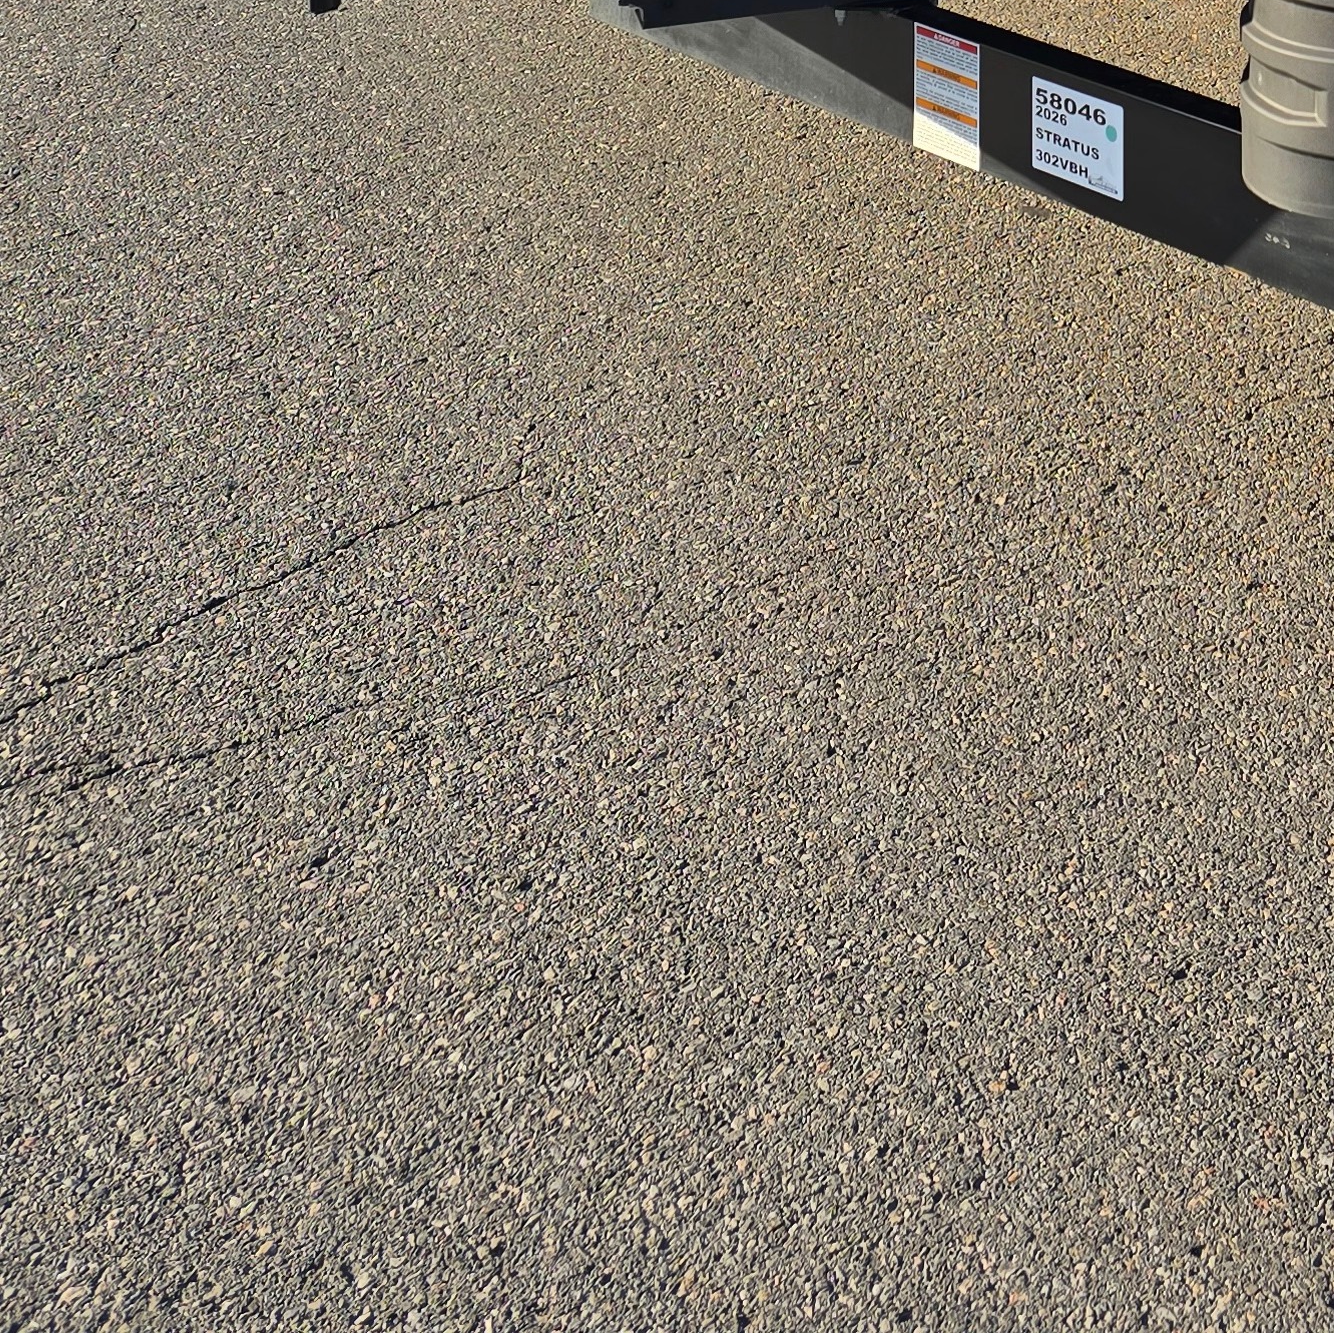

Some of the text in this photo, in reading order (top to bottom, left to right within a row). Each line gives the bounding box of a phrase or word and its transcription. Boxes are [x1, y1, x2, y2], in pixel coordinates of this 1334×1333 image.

[1035, 87, 1107, 126] 58046
[1035, 105, 1068, 127] 2026
[1035, 127, 1100, 160] STRATUS
[1035, 149, 1089, 179] 302VBH
